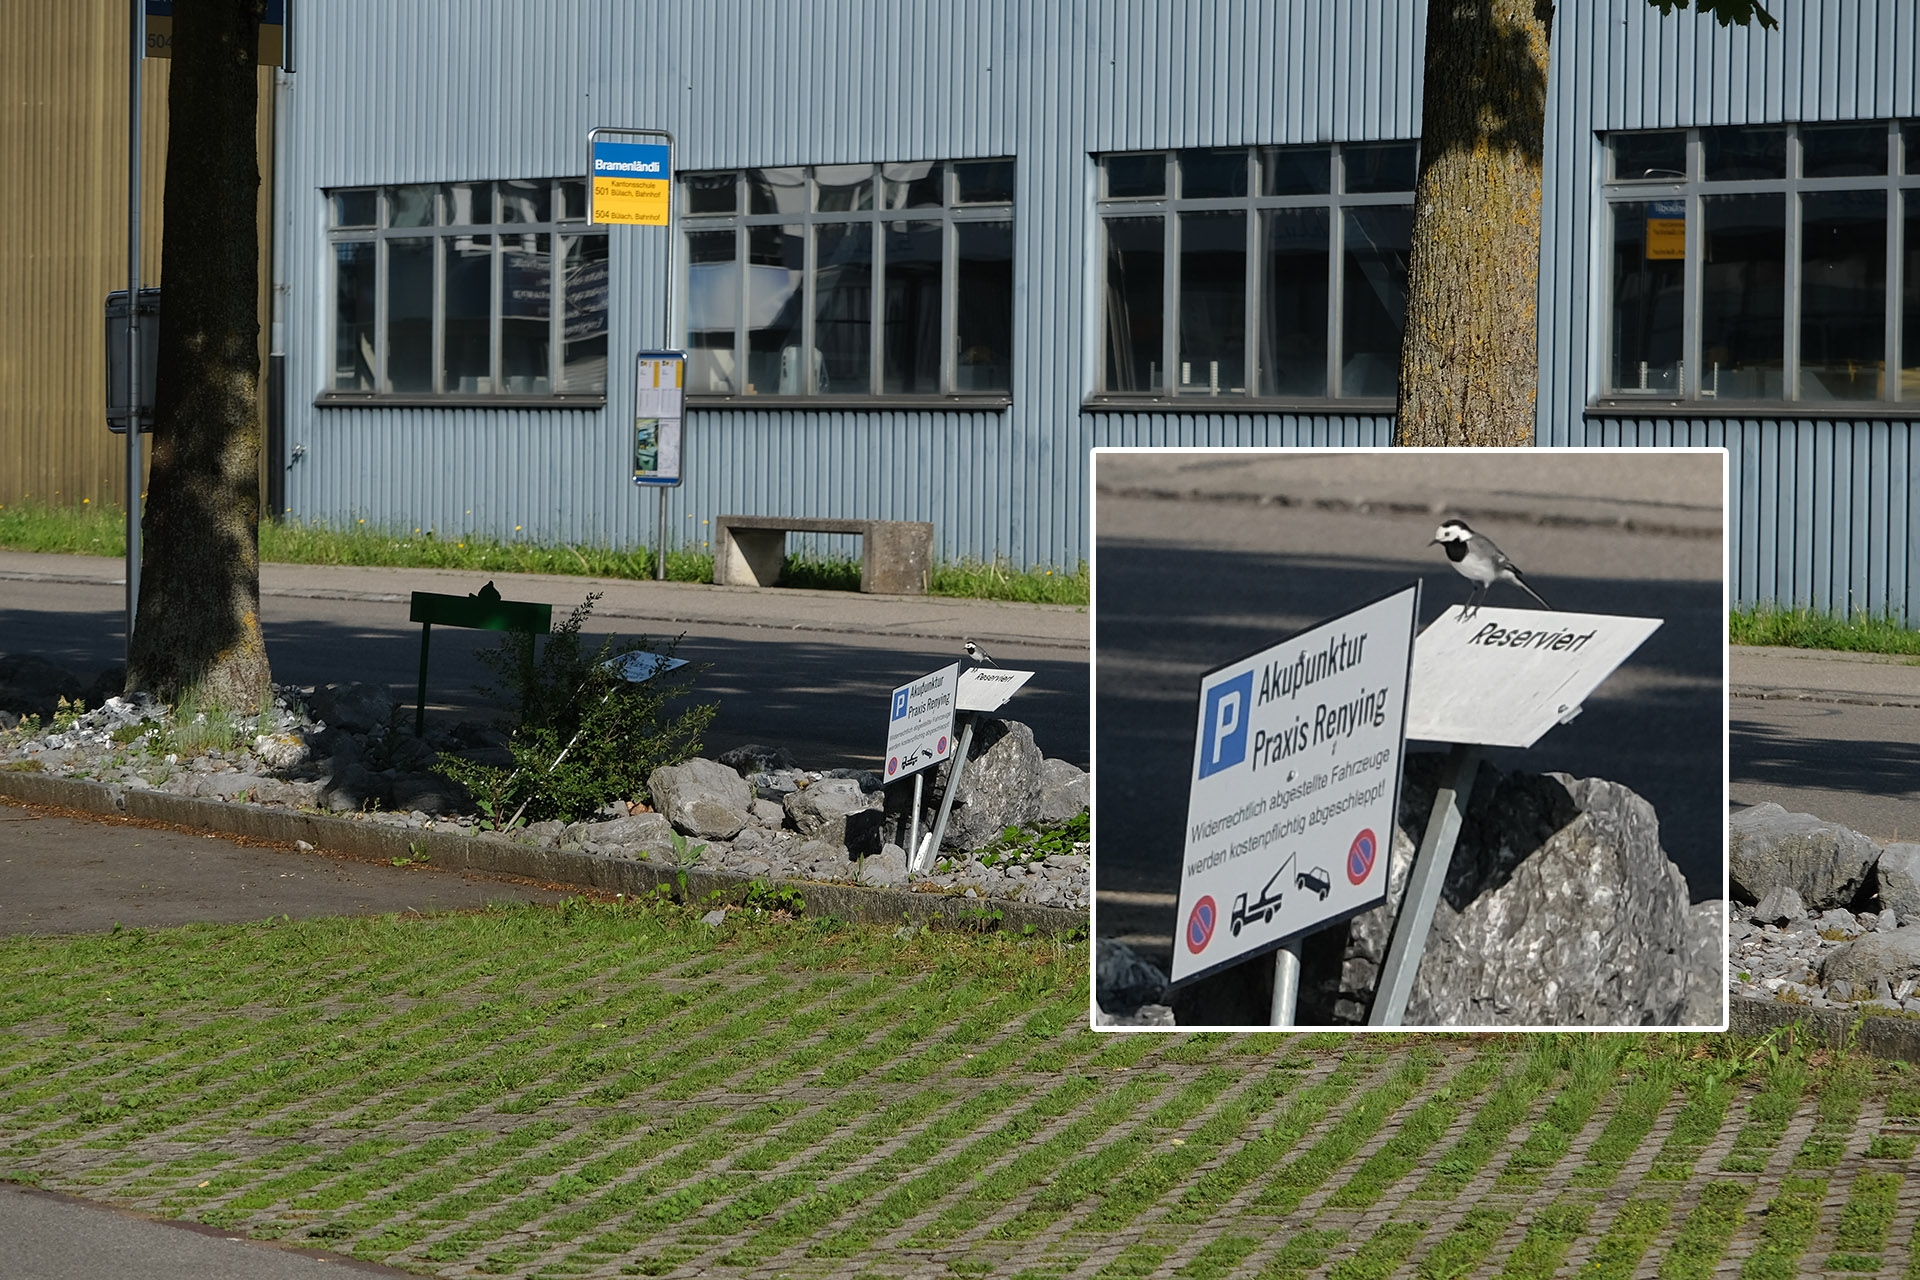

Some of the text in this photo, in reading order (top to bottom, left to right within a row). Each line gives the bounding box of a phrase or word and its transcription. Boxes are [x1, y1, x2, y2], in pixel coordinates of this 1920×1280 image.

[595, 159, 660, 172] Bramenländli
[595, 187, 661, 198] 501 Bülach, Bahnhof
[611, 181, 656, 189] Kantonsschule
[595, 210, 609, 219] 504
[635, 213, 660, 221] Bahnhof
[1467, 622, 1597, 652] Reserviert
[975, 672, 1015, 682] Reserviert
[1258, 633, 1367, 706] Akupunktur
[910, 676, 944, 699] Akupunktur
[908, 702, 926, 719] Praxis
[1213, 691, 1240, 764] P
[1253, 688, 1388, 772] Praxis Renying
[1191, 749, 1390, 844] Widerrechtlich abgestellte Fahrzeuge
[1187, 778, 1386, 877] werden kostenpflichtig abgeschleppt!
